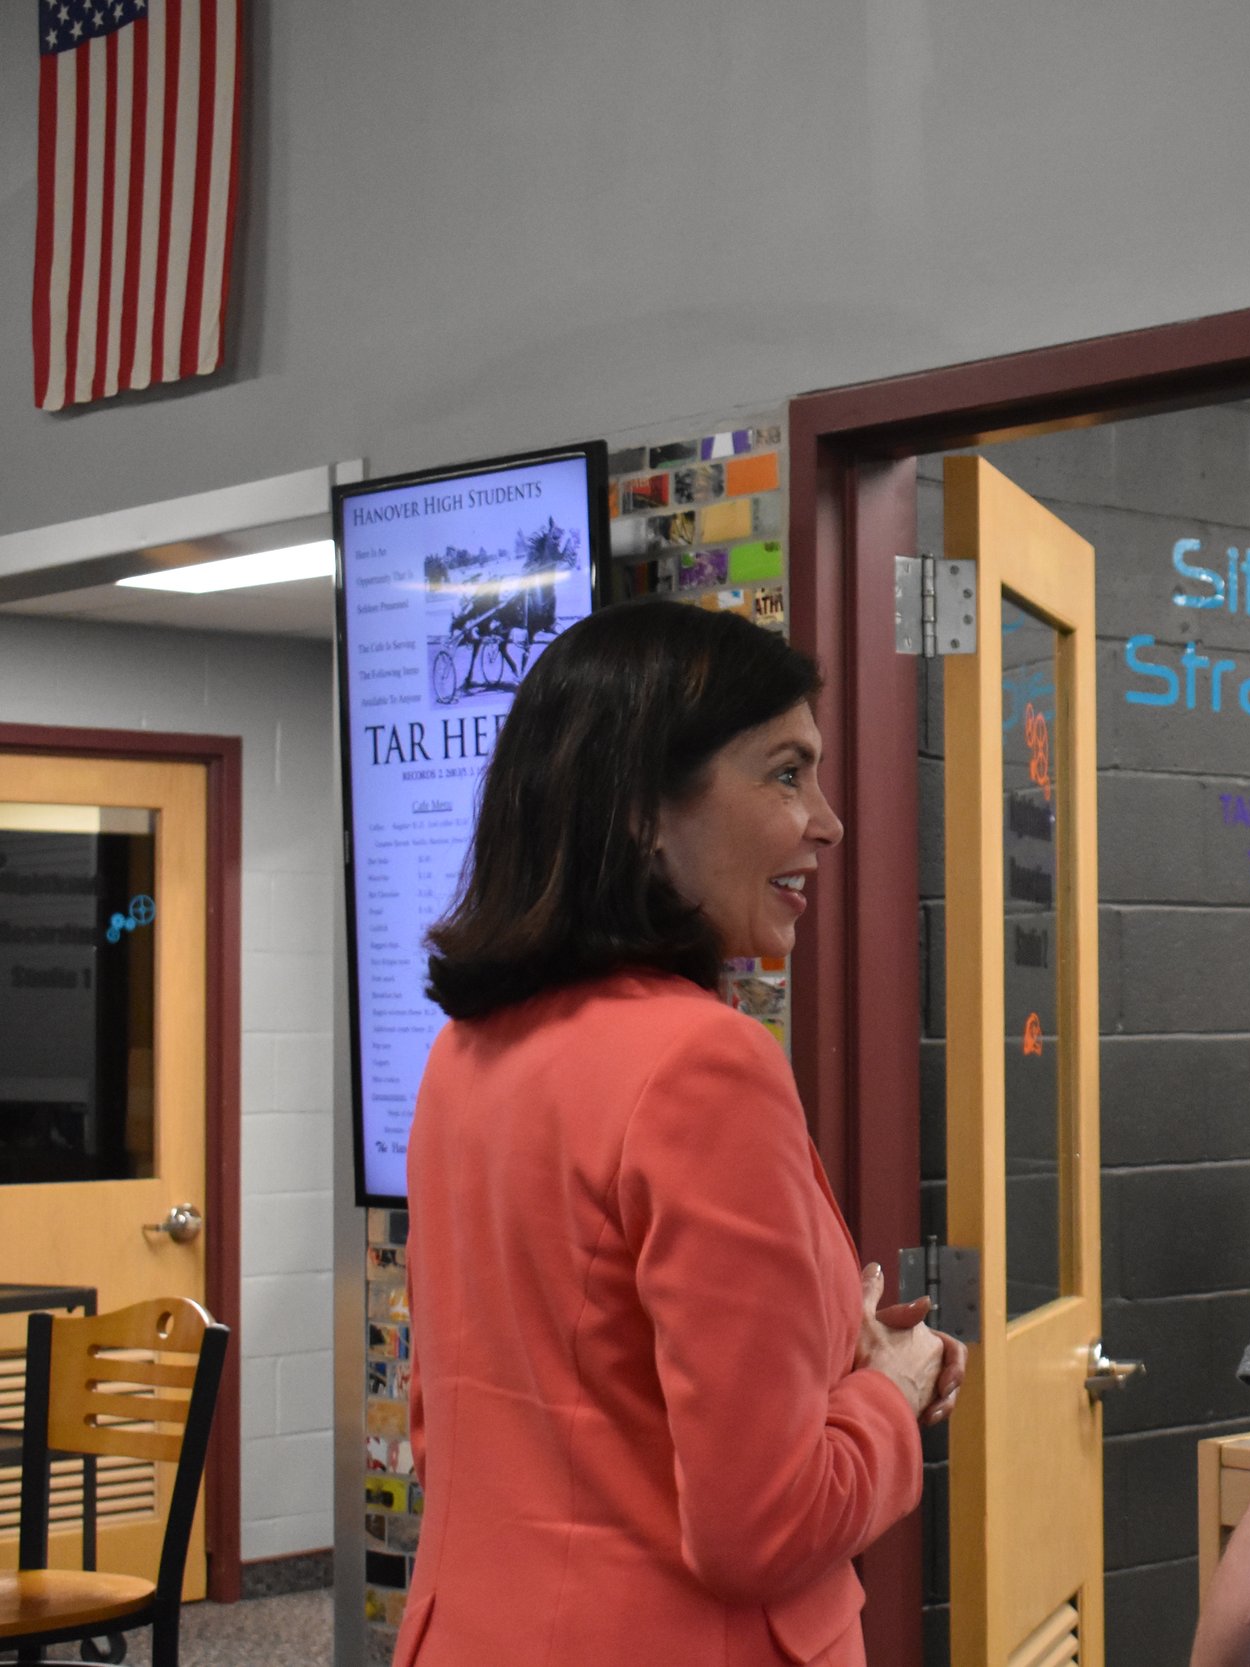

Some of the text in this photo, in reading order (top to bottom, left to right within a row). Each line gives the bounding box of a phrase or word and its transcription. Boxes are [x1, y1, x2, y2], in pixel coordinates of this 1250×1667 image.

[353, 481, 542, 526] HANOVER HIGH STUDENTS
[365, 722, 431, 765] TAR
